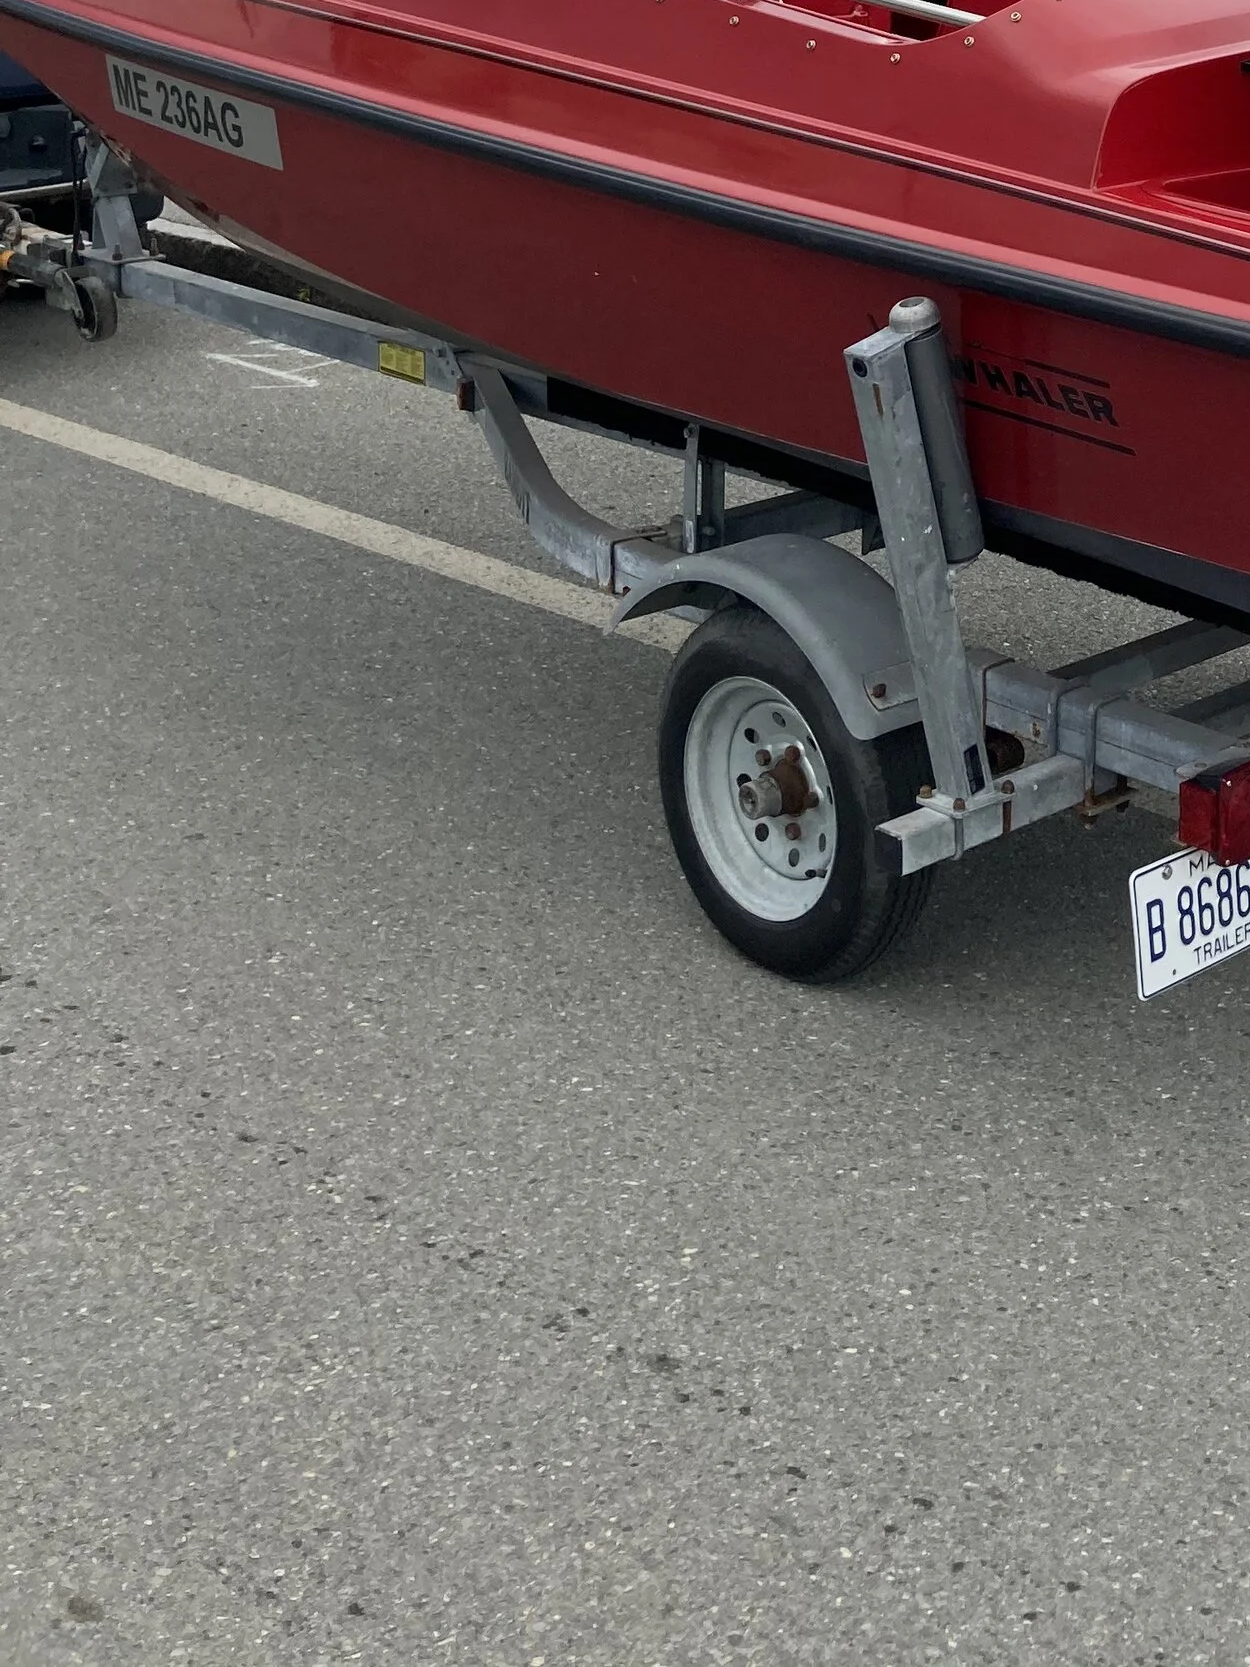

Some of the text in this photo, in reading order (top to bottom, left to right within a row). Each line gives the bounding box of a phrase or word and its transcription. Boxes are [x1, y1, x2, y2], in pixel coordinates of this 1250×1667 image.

[112, 64, 244, 148] ME 236AG
[1146, 898, 1167, 963] B
